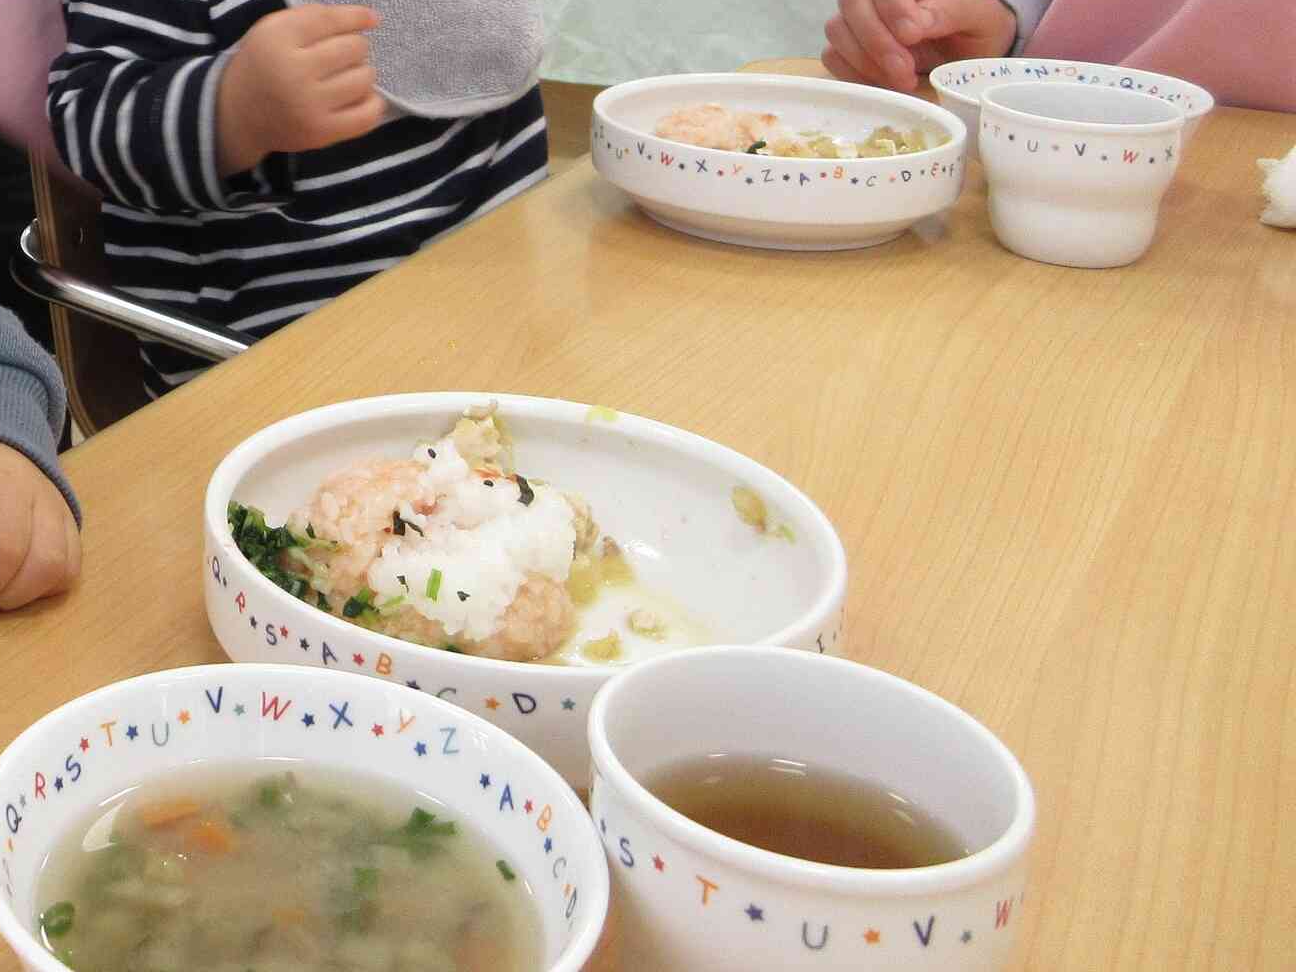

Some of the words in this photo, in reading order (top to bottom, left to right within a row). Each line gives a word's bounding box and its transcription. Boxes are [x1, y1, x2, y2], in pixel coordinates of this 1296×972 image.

[999, 65, 1012, 77] M
[1119, 77, 1134, 90] Q
[636, 141, 646, 156] V
[660, 150, 675, 166] W
[695, 159, 708, 173] X
[761, 168, 774, 183] Z
[799, 171, 811, 187] A
[833, 165, 844, 180] B
[865, 175, 878, 188] C
[901, 170, 912, 182] D
[930, 162, 940, 177] E
[1026, 139, 1039, 153] U
[1074, 143, 1086, 157] V
[1122, 149, 1139, 164] W
[211, 555, 222, 584] Q
[265, 624, 278, 646] S
[321, 641, 337, 665] A
[376, 652, 393, 676] B
[512, 692, 537, 714] D
[6, 803, 22, 833] Q
[35, 771, 47, 801] R
[65, 754, 82, 782] S
[100, 720, 118, 747] T
[151, 722, 170, 747] U
[205, 685, 224, 714] V
[261, 691, 292, 721] W
[328, 701, 354, 730] X
[396, 707, 417, 734] Y
[439, 726, 460, 755] Z
[499, 783, 515, 812] A
[537, 803, 553, 832] B
[552, 856, 568, 879] C
[618, 837, 635, 869] S
[695, 873, 720, 907] T
[800, 920, 829, 950] U
[913, 914, 935, 947] V
[994, 897, 1014, 931] W
